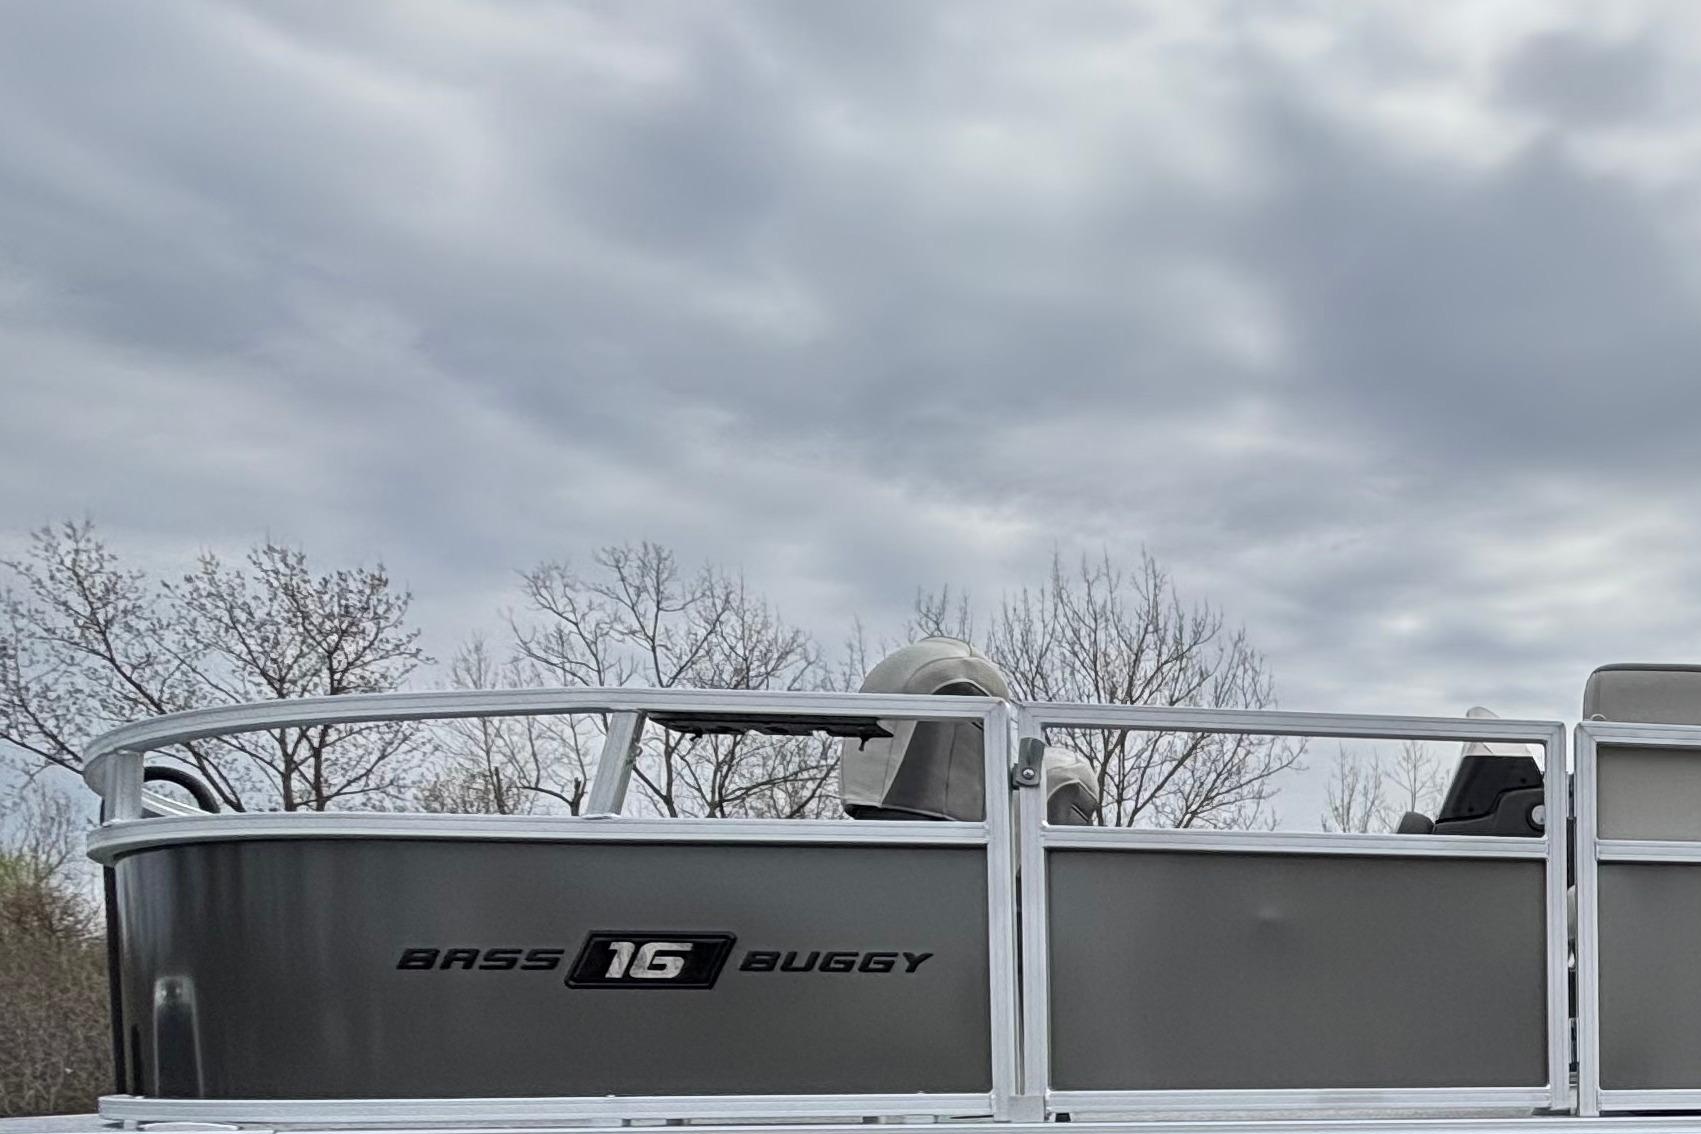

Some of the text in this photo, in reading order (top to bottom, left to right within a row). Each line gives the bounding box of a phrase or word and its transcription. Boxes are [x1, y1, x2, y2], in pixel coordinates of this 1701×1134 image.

[396, 941, 934, 979] BASS 16 BUGGY
